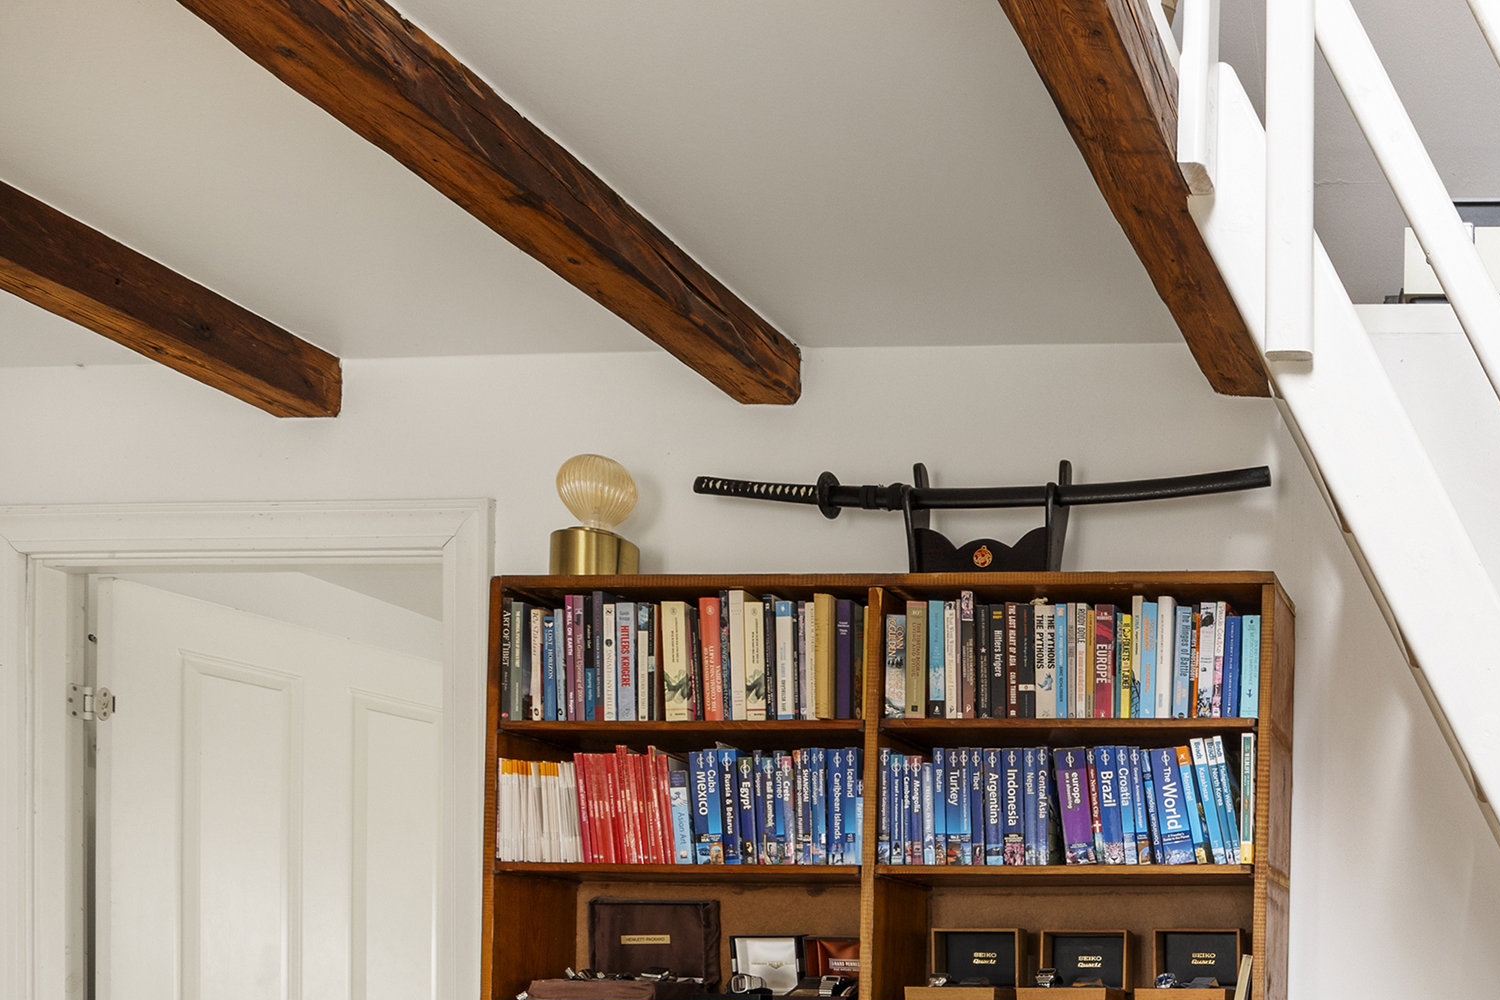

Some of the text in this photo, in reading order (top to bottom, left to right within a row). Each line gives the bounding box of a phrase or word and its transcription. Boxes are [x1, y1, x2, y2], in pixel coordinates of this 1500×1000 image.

[502, 610, 512, 666] ART OF TIBET
[888, 618, 896, 656] IGGULDEN
[896, 626, 904, 650] CONN
[1036, 615, 1044, 670] THE PYTHONS
[1077, 608, 1086, 644] RODDY DOYLE
[620, 626, 630, 688] HITLERS KRIGERE
[992, 630, 1003, 678] Hitlers krigere
[1096, 644, 1108, 684] EUROPE
[1122, 638, 1131, 690] FOLKETS TJENER
[708, 770, 716, 793] Cuba
[724, 774, 732, 797] Russia
[846, 769, 854, 798] Iceland
[948, 770, 960, 806] Turkey
[972, 772, 980, 790] Tibet
[1026, 772, 1034, 795] Nepal
[1072, 772, 1081, 804] europe
[1100, 771, 1116, 808] Brazil
[1119, 768, 1130, 806] Croatia
[1194, 742, 1210, 802] Bradt Kazakhstan
[696, 772, 708, 816] MEXICO
[741, 781, 751, 810] Egypt
[833, 772, 842, 840] Caribbean Islands
[912, 780, 920, 813] Mongolia
[987, 773, 998, 824] Argentina
[1006, 769, 1018, 826] Indonesia
[1038, 770, 1047, 818] Central Asia
[1162, 767, 1182, 830] The World
[726, 806, 734, 835] Belarus
